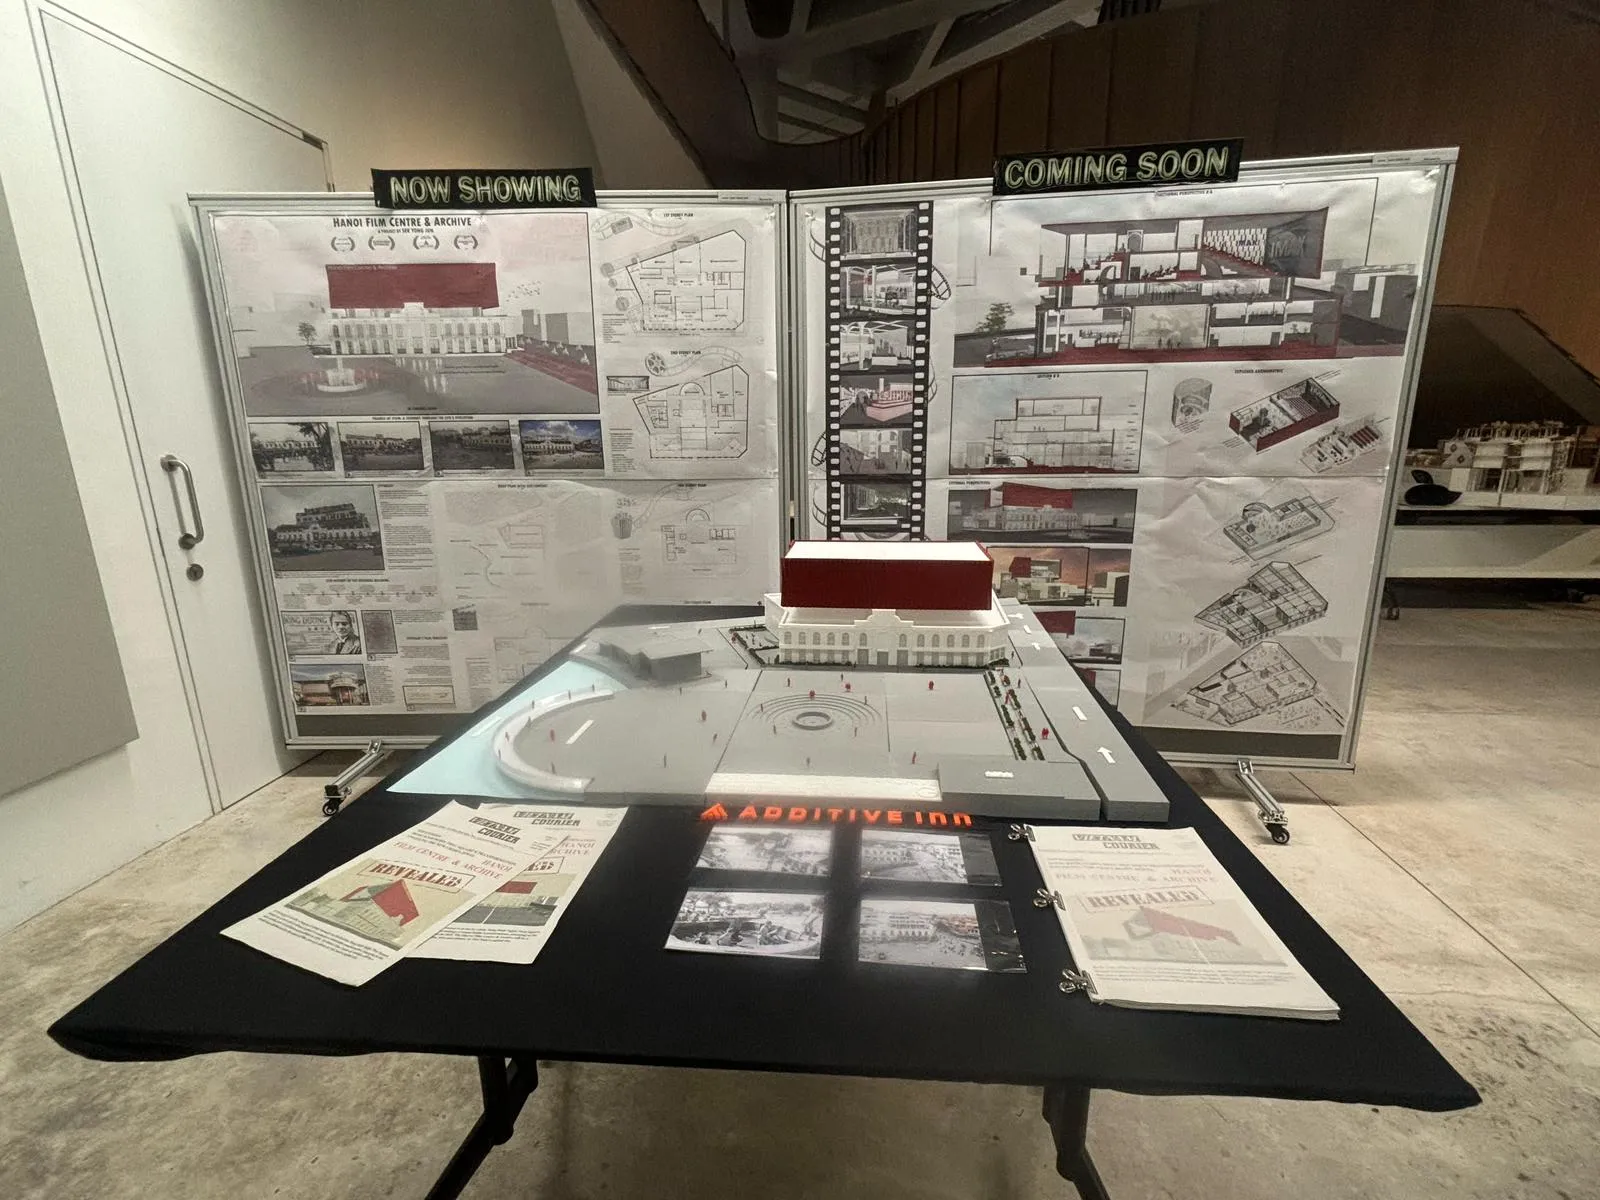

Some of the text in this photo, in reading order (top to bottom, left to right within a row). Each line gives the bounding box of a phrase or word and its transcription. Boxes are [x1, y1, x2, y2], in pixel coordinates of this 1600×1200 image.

[1004, 146, 1229, 189] COMING SOON
[390, 174, 581, 204] NOW SHOWING
[333, 216, 472, 227] HANOI FILM CENTRE & ARCHIVE
[531, 819, 581, 827] COURIER
[738, 804, 903, 825] ADDITIVE
[478, 827, 521, 844] COURIER
[1103, 842, 1161, 850] COURIER
[393, 841, 416, 850] FILM
[416, 846, 449, 863] CENTRE
[463, 863, 504, 880] ARCHIVE
[482, 860, 514, 872] HANOI
